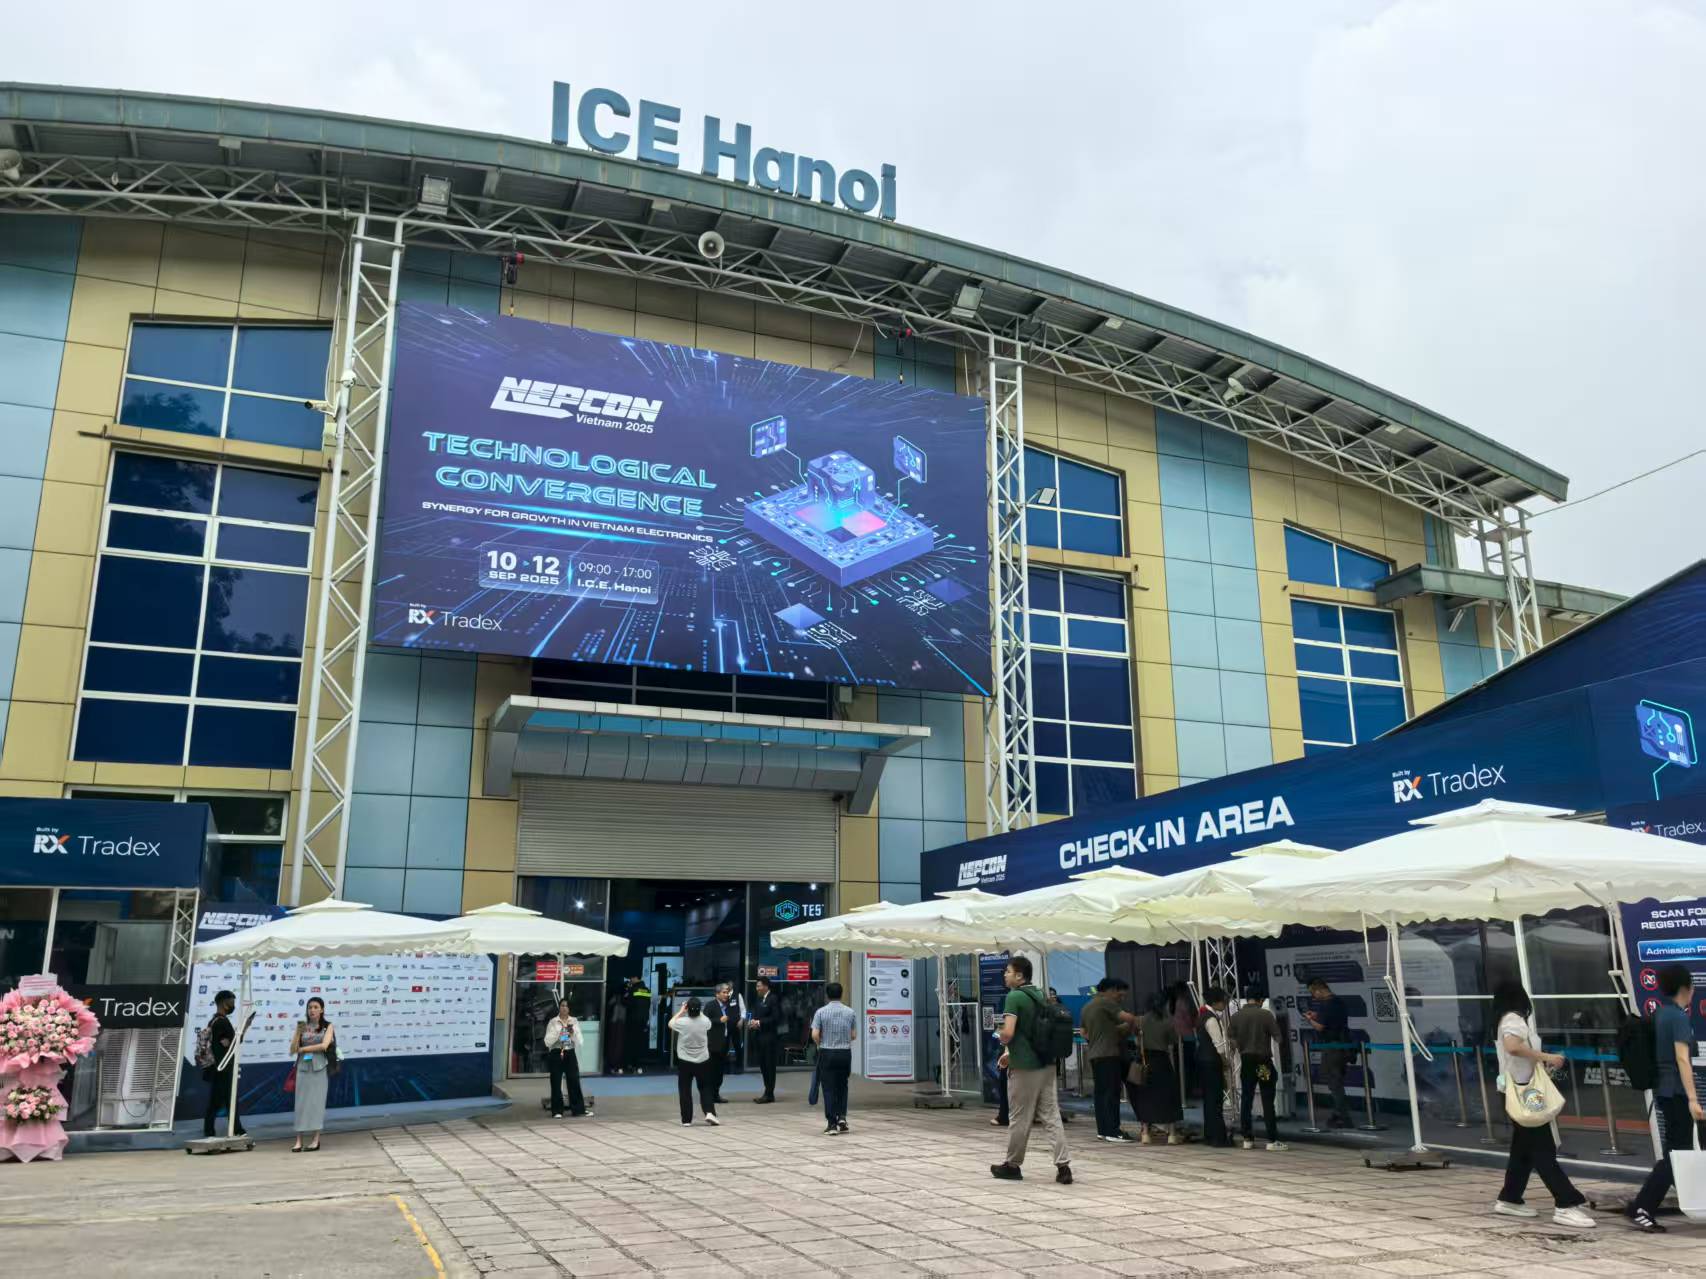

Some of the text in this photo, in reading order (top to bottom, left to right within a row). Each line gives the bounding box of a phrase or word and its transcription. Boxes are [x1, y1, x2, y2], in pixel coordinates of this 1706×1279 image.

[552, 80, 896, 221] ICE Hanoi
[490, 376, 663, 423] NEPCON
[576, 413, 654, 434] Vietnam 2025
[422, 431, 717, 489] TECHNOLOGICAL
[435, 466, 704, 517] CONVERGENCE
[422, 501, 714, 544] SYNERGY FOR GROWTH IN VIETNAM ELECTRONICS
[487, 550, 560, 575] 10 12
[578, 561, 612, 576] 09:00
[622, 567, 652, 581] 17:00
[489, 570, 560, 586] SEP 2025
[577, 578, 652, 595] I.C.E. Hanoi
[408, 608, 502, 631] RX Tradex
[1392, 763, 1507, 804] RX Tradex
[1059, 796, 1296, 870] CHECK-IN AREA
[1654, 820, 1704, 838] Tradex
[33, 834, 161, 857] RX Tradex
[957, 854, 1008, 888] NEPCON
[198, 911, 273, 931] NEPCON
[802, 903, 825, 917] TES
[1650, 908, 1685, 919] SCAN
[1646, 946, 1696, 956] Admission
[99, 996, 180, 1017] Tradex
